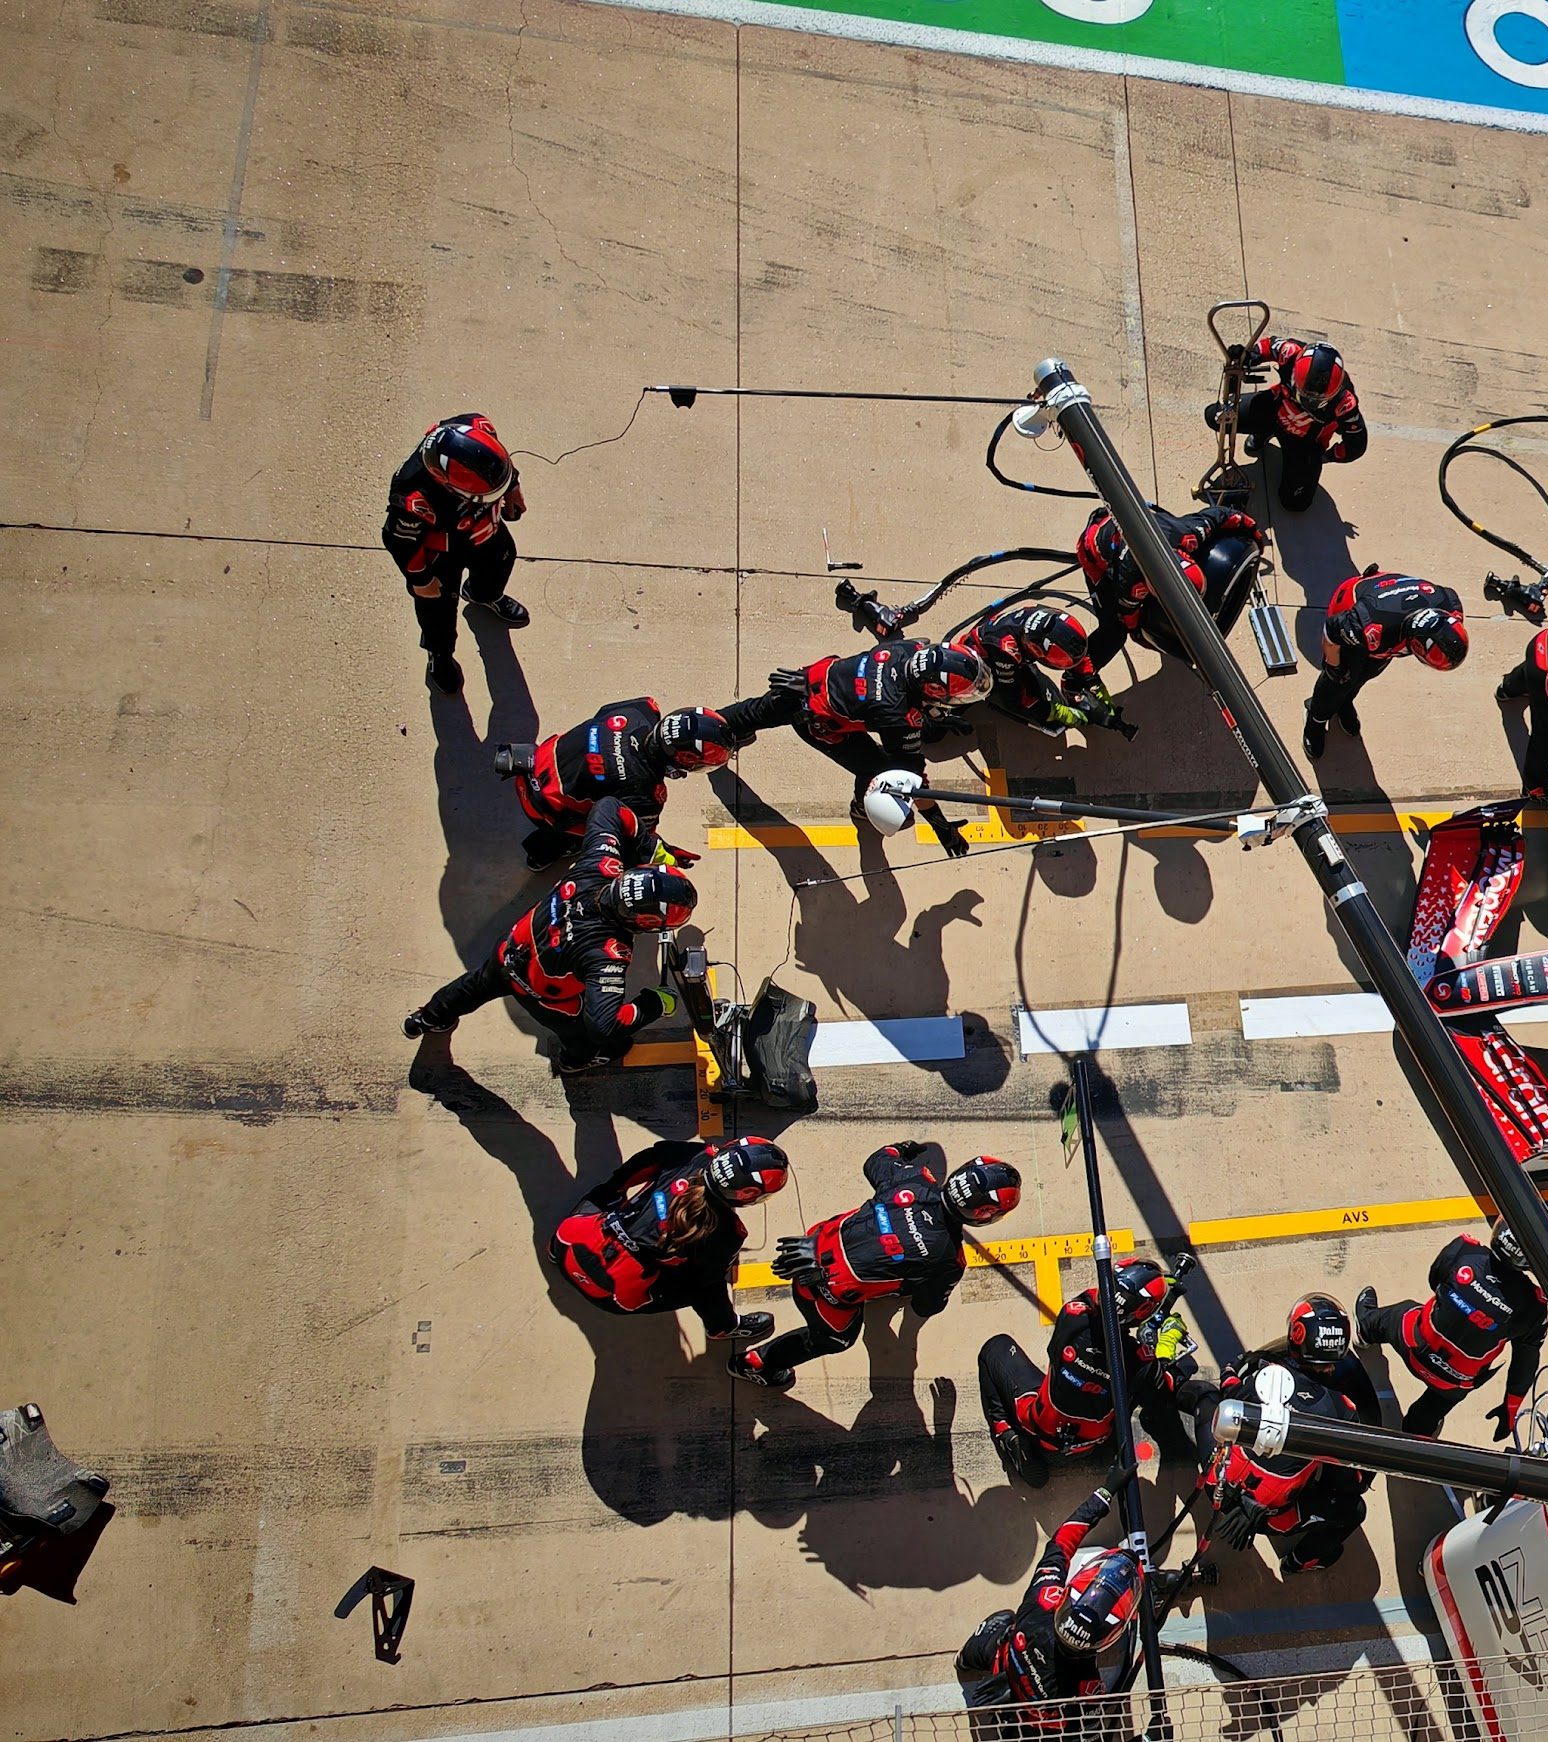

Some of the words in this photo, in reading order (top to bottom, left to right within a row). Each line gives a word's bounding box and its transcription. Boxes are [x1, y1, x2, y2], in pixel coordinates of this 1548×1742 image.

[669, 713, 682, 739] Palm
[612, 731, 627, 780] MoneyGram
[1234, 728, 1259, 768] TOYOTA
[586, 753, 606, 776] GO
[633, 873, 645, 901] Palm
[701, 1110, 710, 1120] 30
[722, 1152, 734, 1180] Palm
[957, 1172, 972, 1198] Palm
[1343, 1211, 1369, 1224] AVS
[879, 1233, 903, 1256] GO
[903, 1207, 929, 1257] MoneyGram
[973, 1255, 984, 1263] 30
[996, 1253, 1006, 1261] 20
[1064, 1246, 1073, 1254] 10
[1469, 1280, 1513, 1316] MoneyGram
[1318, 1325, 1343, 1338] Palm
[1468, 1310, 1492, 1331] GO
[1315, 1336, 1345, 1349] Angels
[1059, 1623, 1090, 1649] Angels
[1065, 1615, 1091, 1640] Palm
[1021, 1649, 1048, 1699] MoneyGram
